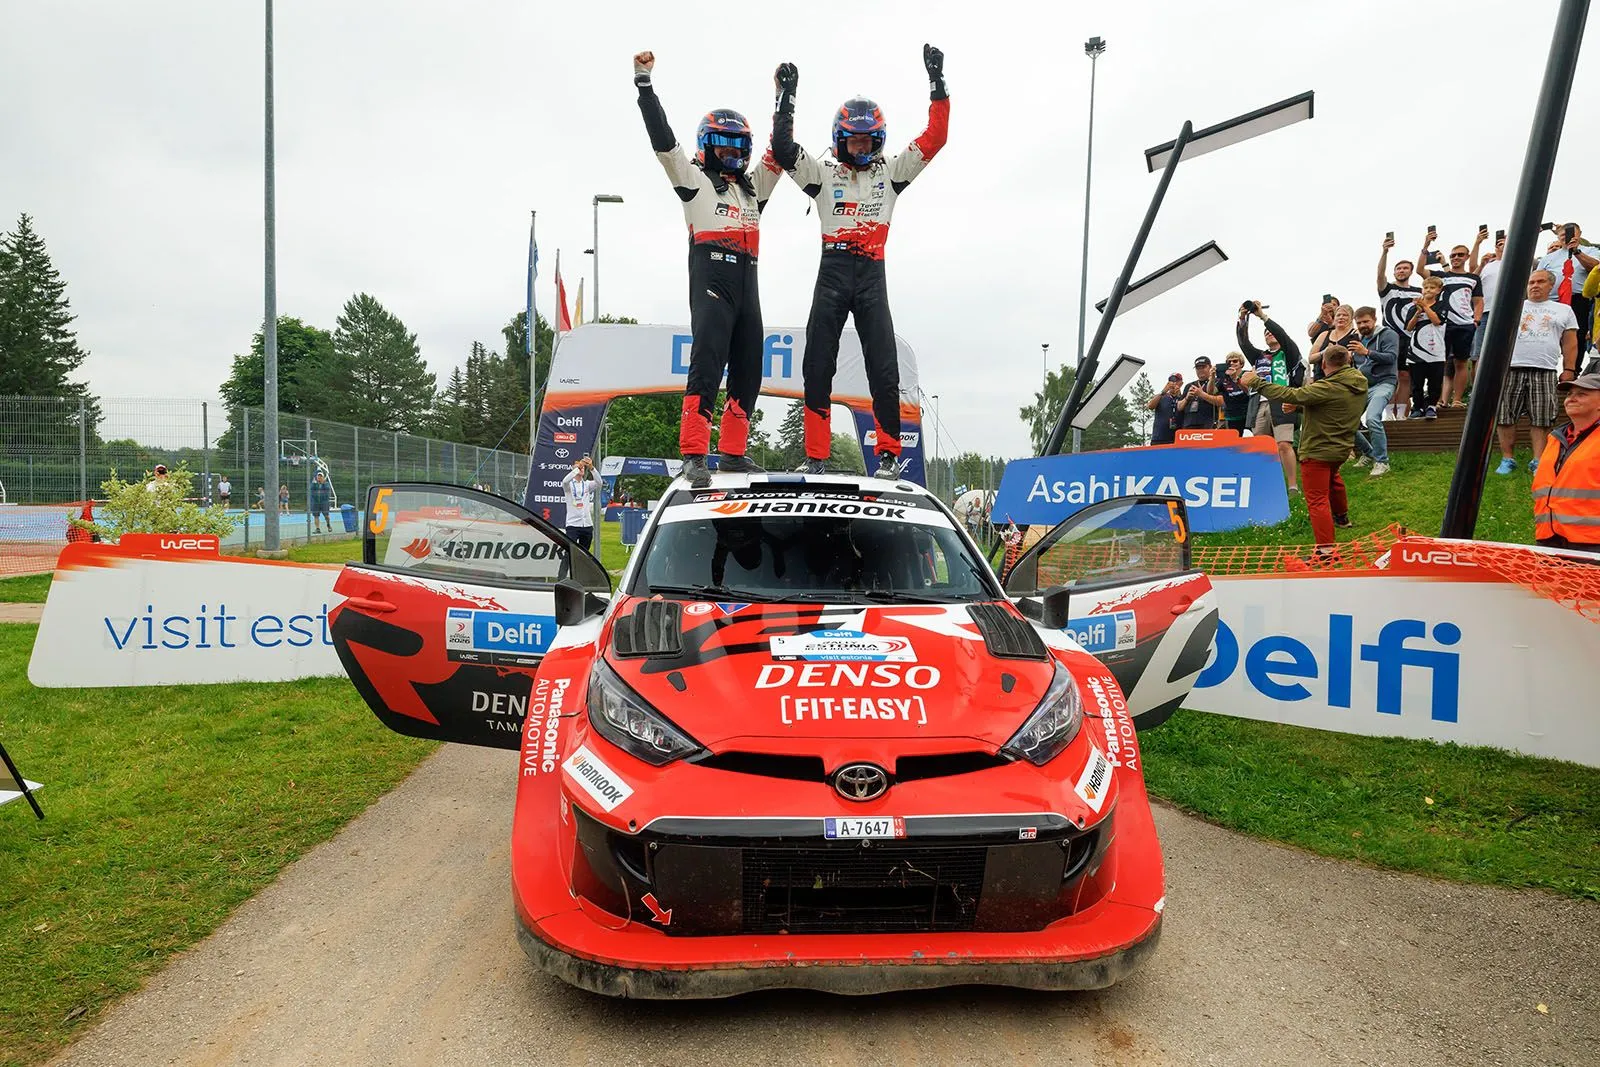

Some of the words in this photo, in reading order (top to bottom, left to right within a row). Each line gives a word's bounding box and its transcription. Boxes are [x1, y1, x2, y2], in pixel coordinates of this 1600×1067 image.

[1273, 360, 1286, 381] 243
[557, 416, 583, 427] Delfi
[1179, 433, 1214, 441] WRC
[369, 488, 393, 535] 5
[798, 492, 860, 500] GAZOO
[863, 495, 917, 507] Racing
[1167, 500, 1186, 544] 5
[160, 539, 215, 550] WRC
[1402, 549, 1480, 567] WRC
[104, 604, 237, 650] visit
[487, 621, 542, 645] Delfi
[755, 663, 941, 689] DENSO
[524, 678, 550, 776] AUTOMOTIVE
[542, 678, 571, 773] Panasonic
[1087, 676, 1121, 767] Panasonic
[1101, 676, 1138, 771] AUTOMOTIVE
[841, 821, 889, 835] A-7647
